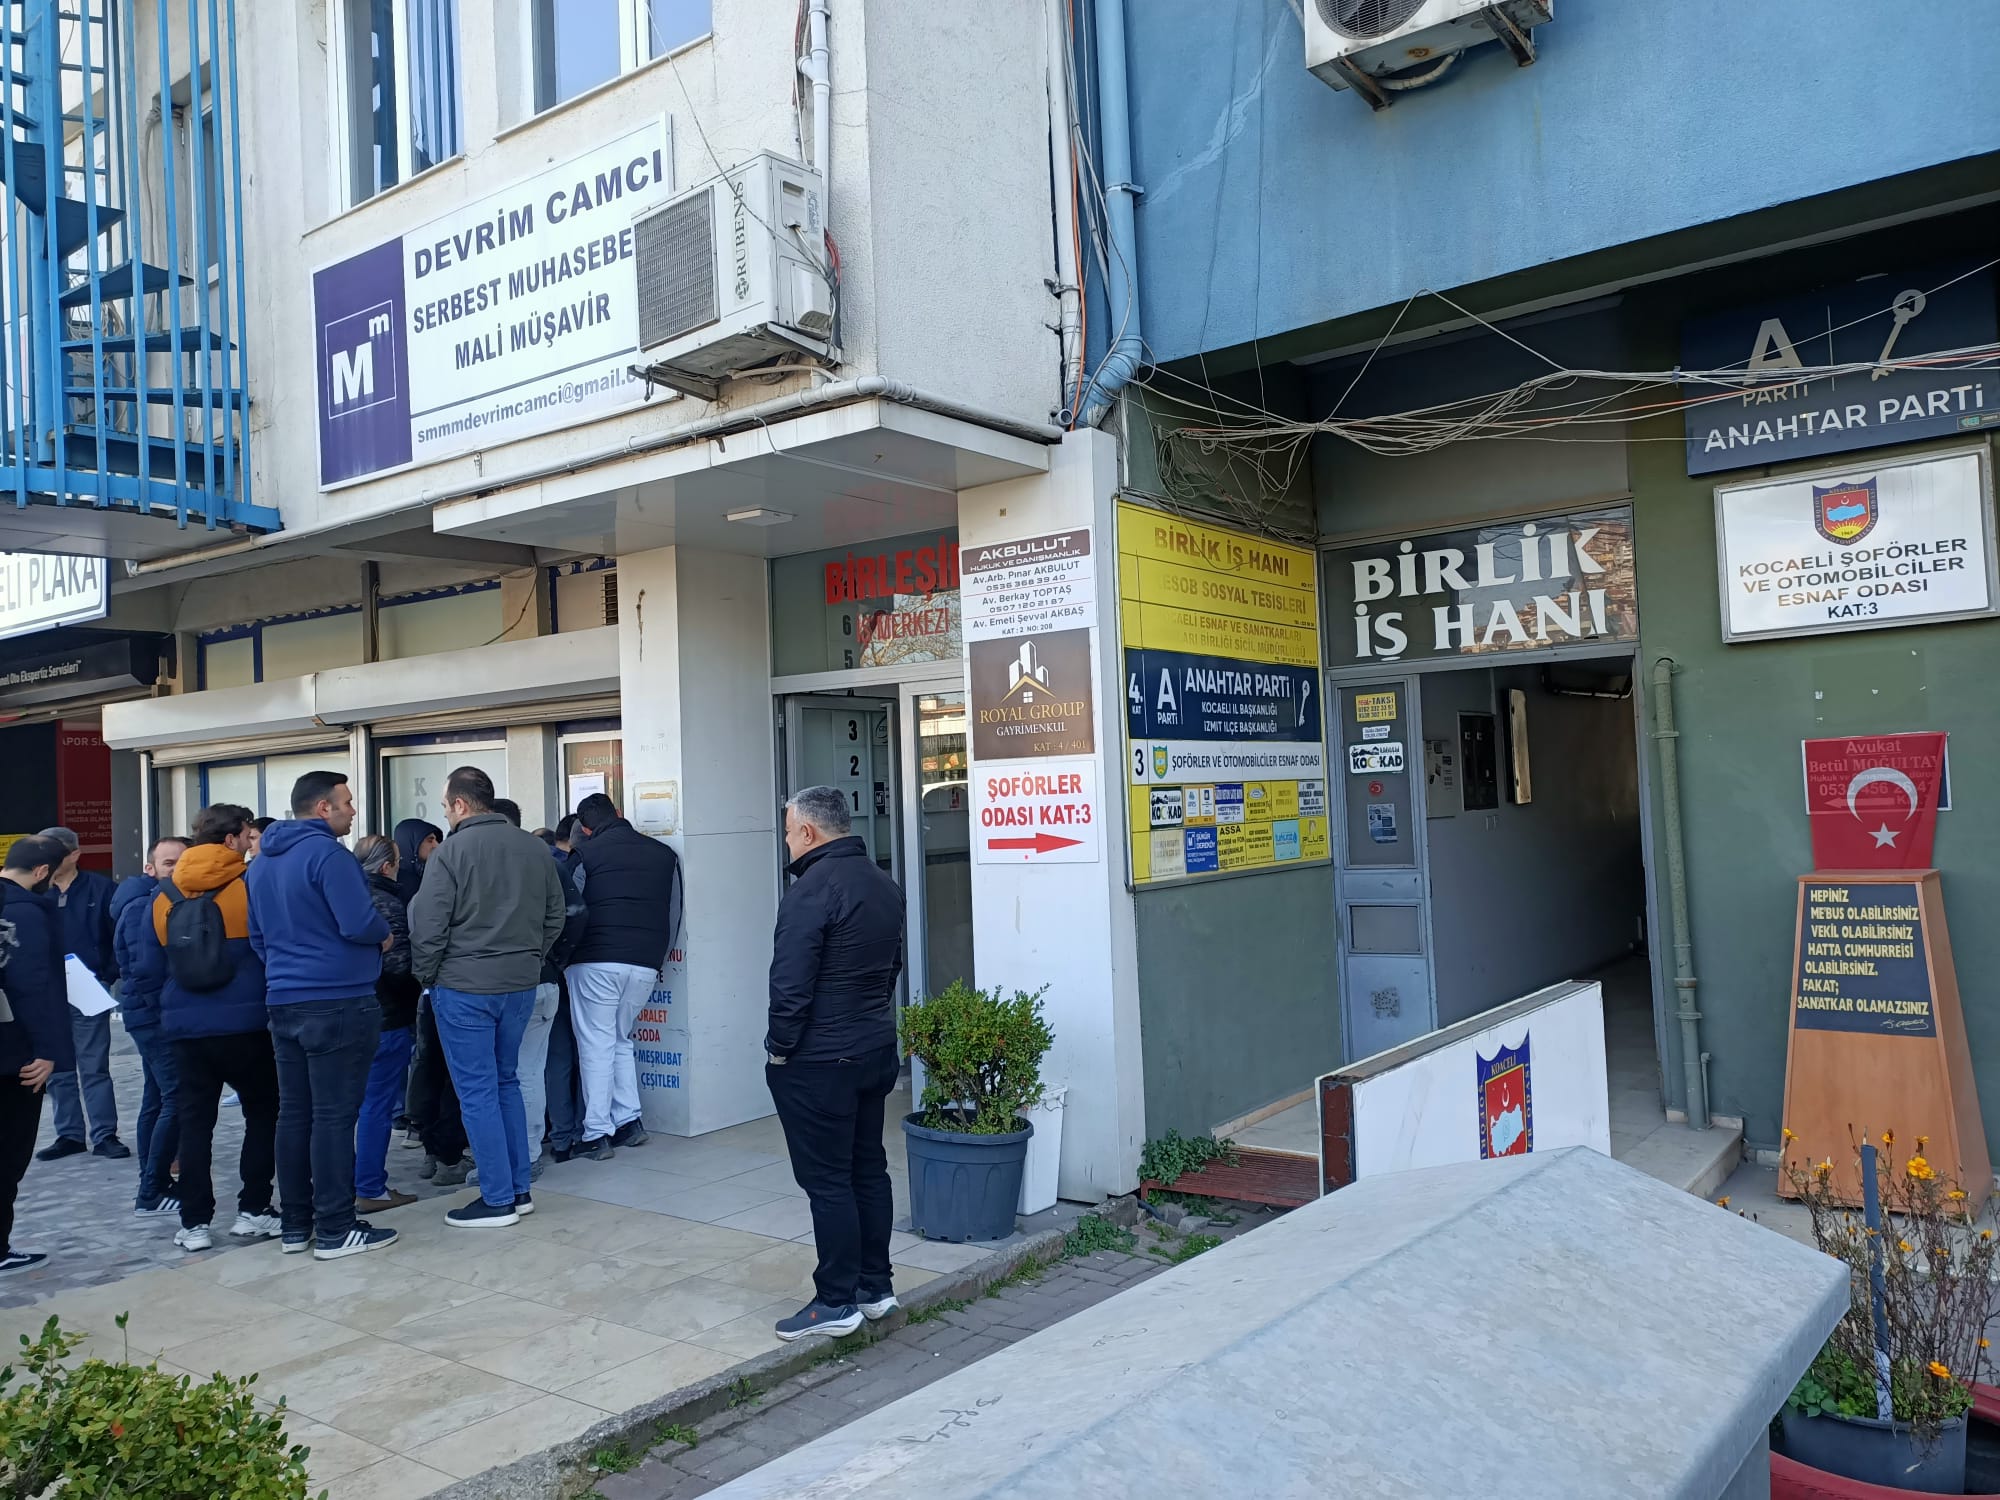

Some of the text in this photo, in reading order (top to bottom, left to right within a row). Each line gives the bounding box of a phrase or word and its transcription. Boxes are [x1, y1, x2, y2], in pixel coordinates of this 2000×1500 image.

[414, 148, 663, 279] DEVRİM CAMCI
[413, 278, 501, 334] SERBEST
[455, 291, 611, 370] MALİ MÜŞAVİR
[1704, 404, 1867, 453] ANAHTAR
[979, 536, 1072, 561] AKBULUT
[1154, 525, 1290, 577] BİRLİK İŞ HANI
[1739, 537, 1967, 578] KOCAELİ ŞOFÖRLER
[970, 561, 1001, 572] HUKUK
[1002, 559, 1014, 567] VE
[1034, 561, 1080, 576] AKBULUT
[1351, 523, 1606, 603] BİRLİK
[29, 555, 98, 606] PLAKA
[1744, 555, 1965, 594] VE OTOMOBİLCİLER
[982, 585, 1072, 606] Av. Berkay TOPTAŞ
[1202, 579, 1248, 605] SOSYAL
[1251, 590, 1307, 615] TESİSLERİ
[1777, 578, 1929, 607] ESNAF ODASI
[973, 606, 1084, 629] Av. Emeti Şevval AKBAŞ
[1827, 602, 1879, 619] KAT:3
[842, 615, 851, 636] 6
[1200, 616, 1228, 631] ESNAF
[1230, 621, 1241, 634] VE
[1354, 589, 1609, 662] İŞ HANI
[844, 650, 853, 669] 5
[1157, 668, 1176, 710] A
[1185, 668, 1252, 696] ANAHTAR
[980, 701, 1085, 724] ROYAL GROUP
[1132, 705, 1142, 714] KAT
[848, 720, 857, 740] 3
[996, 722, 1068, 737] GAYRİMENKUL
[1846, 740, 1902, 754] Avukat
[850, 755, 859, 776] 2
[1135, 749, 1144, 776] 3
[1172, 753, 1320, 771] ŞOFÖRLER VE OTOMOBİLCİLER ESNAF ODASI
[1809, 760, 1848, 773] Betül
[987, 771, 1083, 802] ŞOFÖRLER
[852, 791, 859, 811] 1
[981, 803, 1092, 827] ODASI KAT:3
[1219, 825, 1241, 836] ASSA
[1302, 834, 1325, 844] PLUS
[1810, 888, 1849, 903] HEPİNİZ
[1847, 905, 1919, 921] OLABİLİRSİNİZ
[1811, 923, 1914, 940] VEKİL OLABİLİRSİNİZ
[1808, 942, 1914, 958] HATTA CUMHURREİSİ
[1856, 999, 1929, 1015] OLAMAZSINIZ
[638, 1029, 661, 1042] SODA
[638, 1050, 682, 1067] MEŞRUBAT
[641, 1071, 680, 1090] ÇEŞİTLERİ
